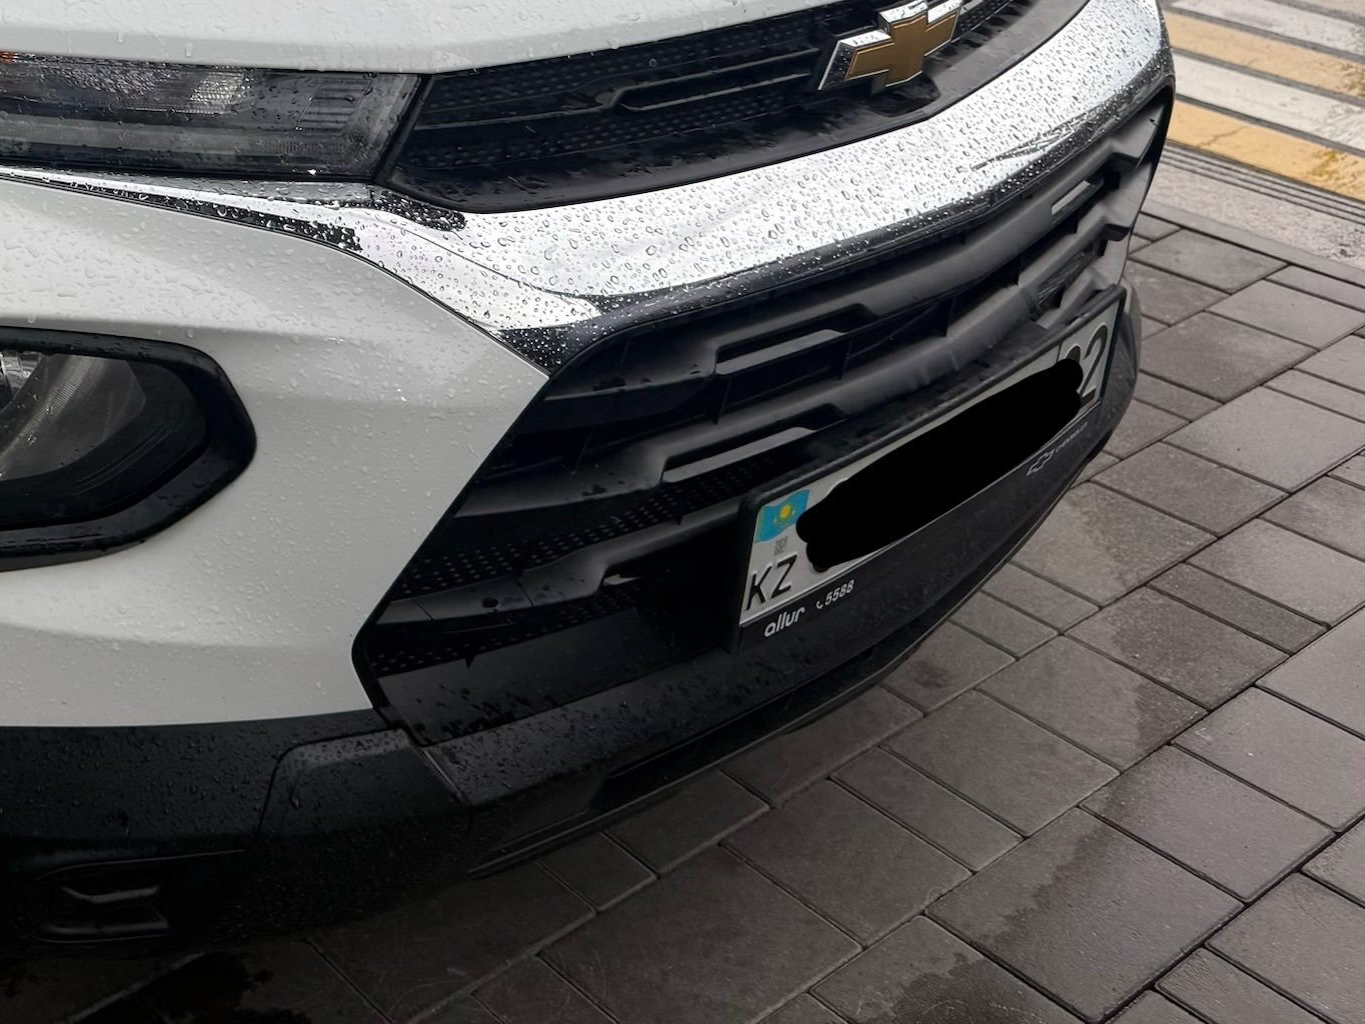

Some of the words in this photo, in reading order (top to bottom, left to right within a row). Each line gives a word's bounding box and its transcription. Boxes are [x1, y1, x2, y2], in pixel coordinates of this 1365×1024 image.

[745, 553, 797, 611] KZ
[764, 607, 806, 637] allur
[825, 579, 855, 605] 5588
